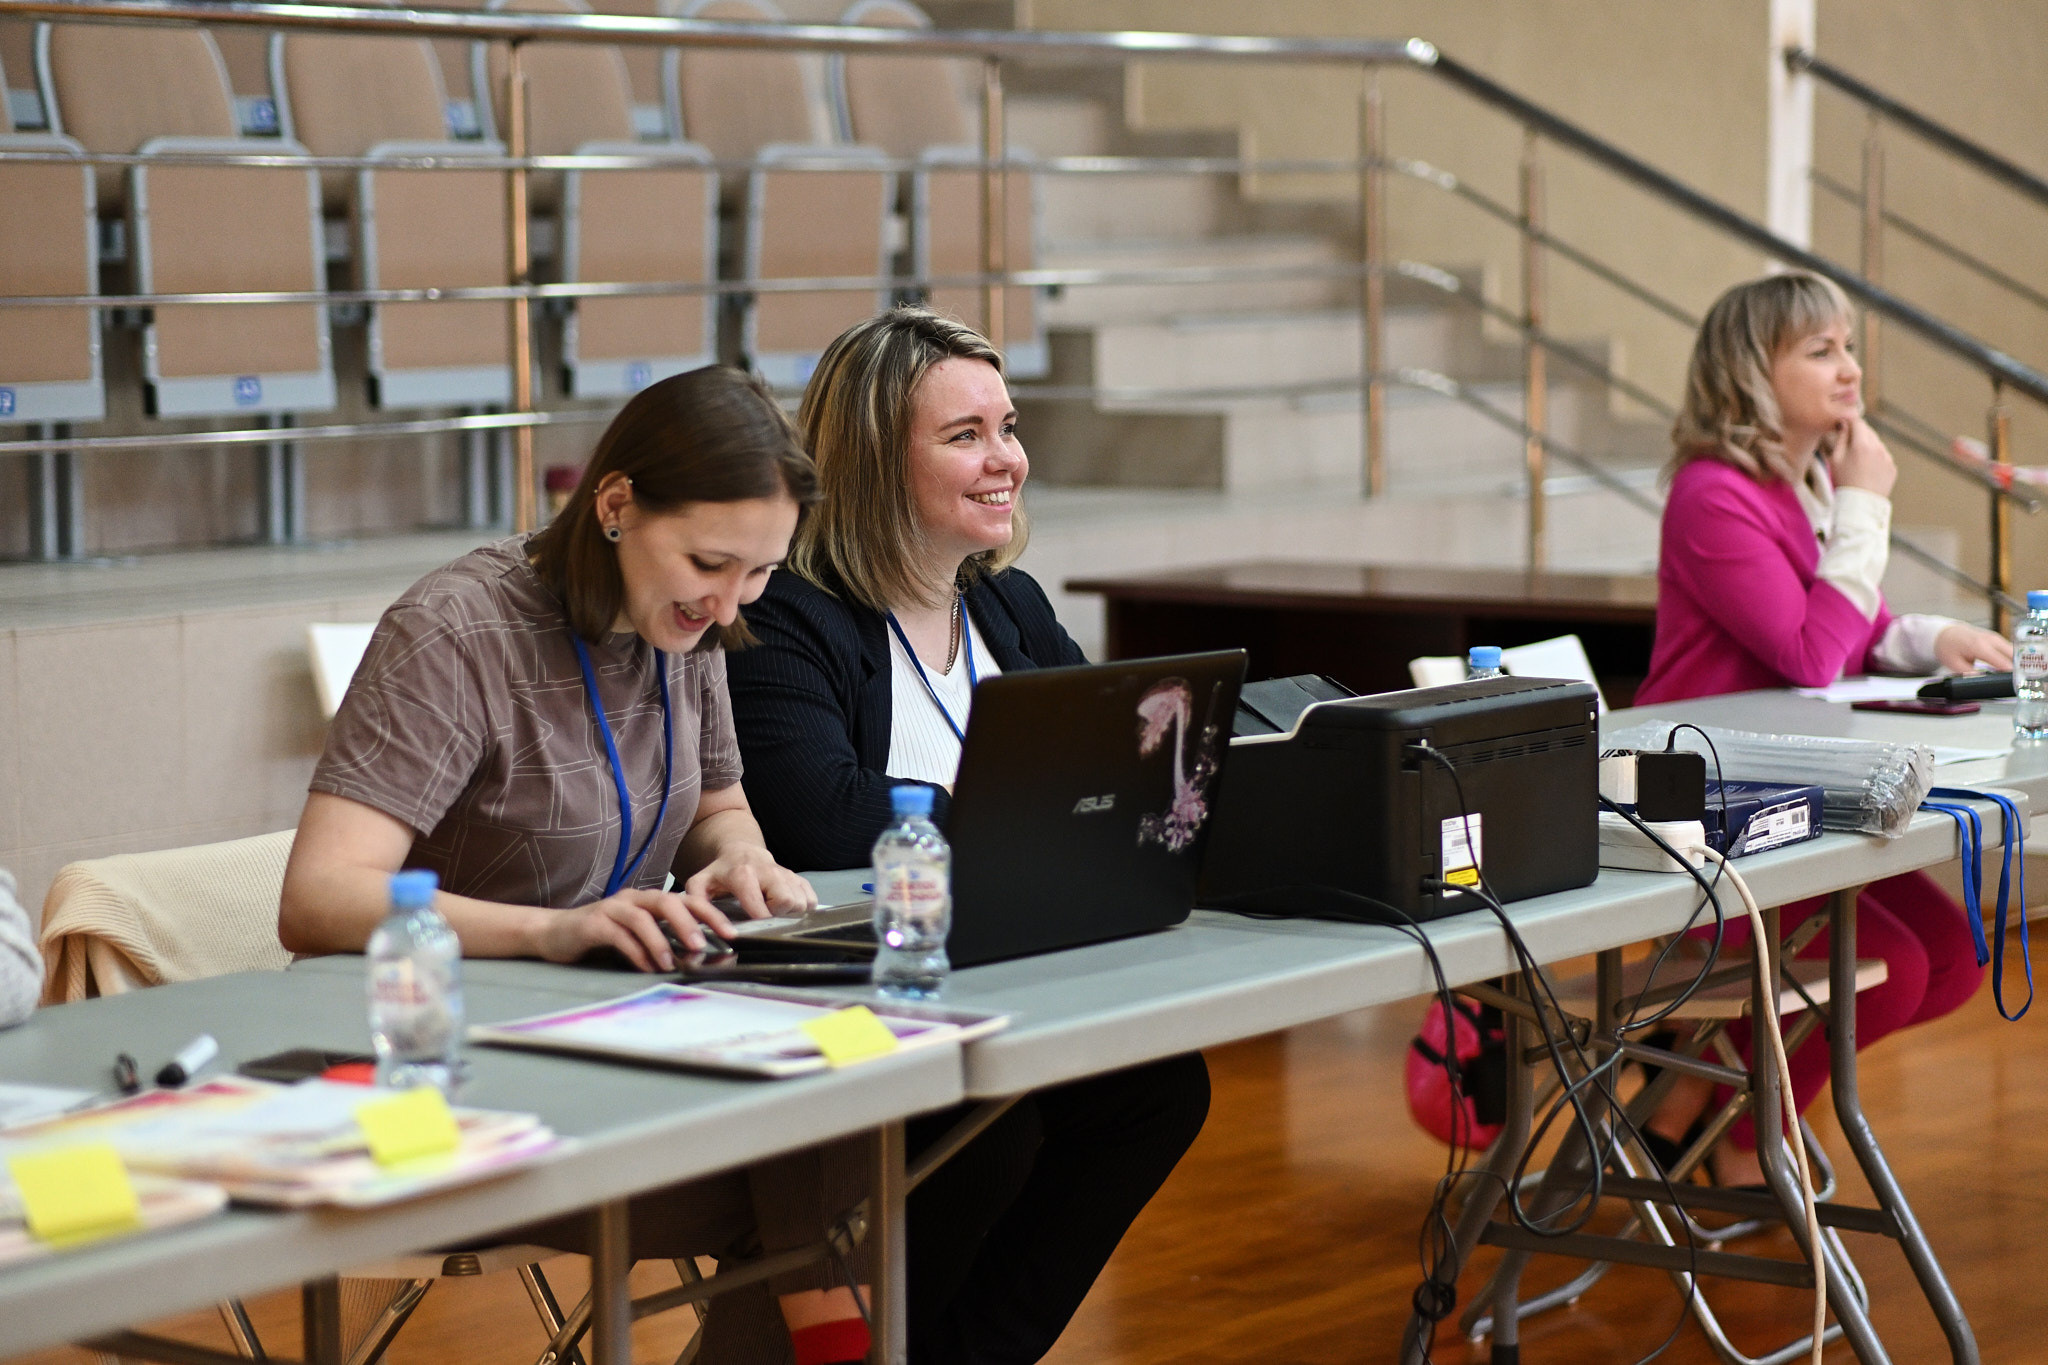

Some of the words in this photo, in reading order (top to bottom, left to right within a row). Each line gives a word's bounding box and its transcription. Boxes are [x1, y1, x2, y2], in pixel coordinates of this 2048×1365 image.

[2021, 653, 2044, 661] saint
[2019, 662, 2048, 671] spring
[1072, 794, 1116, 815] ASUS
